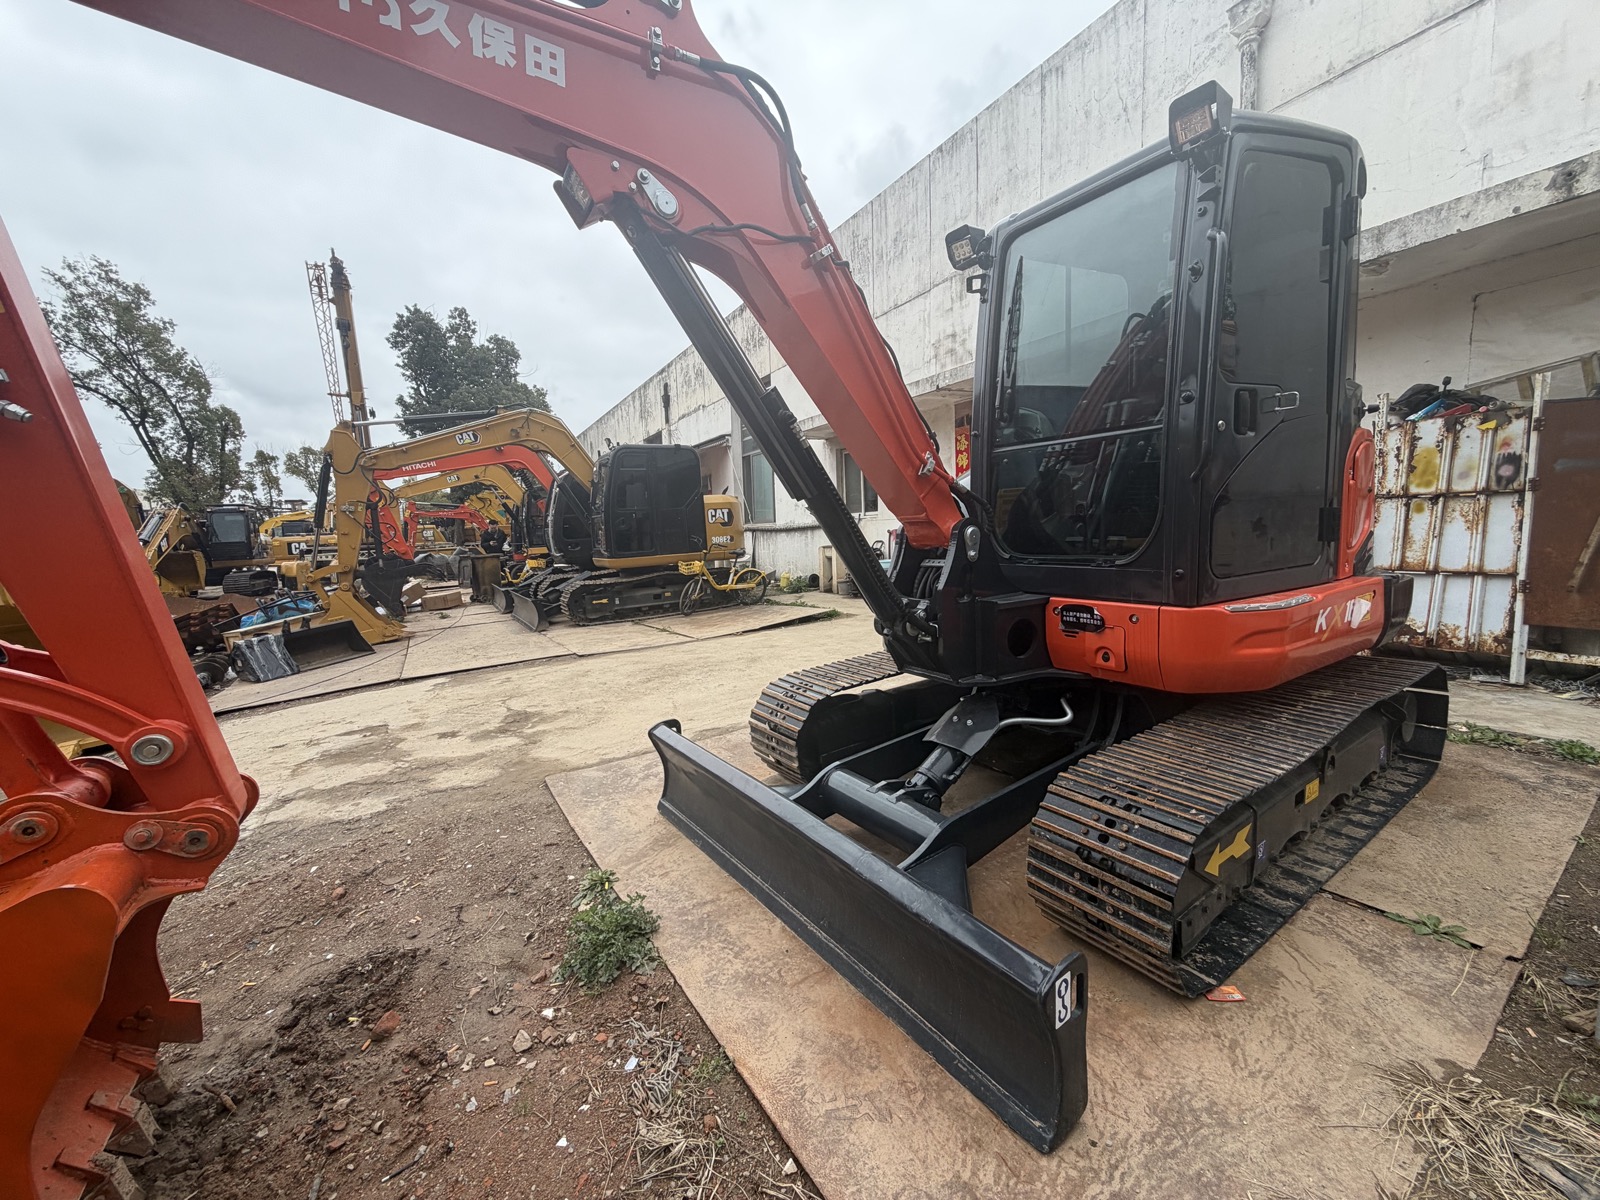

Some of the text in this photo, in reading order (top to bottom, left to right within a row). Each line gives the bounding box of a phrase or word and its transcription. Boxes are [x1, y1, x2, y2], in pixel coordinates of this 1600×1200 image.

[455, 430, 476, 445] CAT
[402, 460, 437, 472] HITACHI
[446, 474, 459, 483] CAT
[707, 508, 729, 524] CAT
